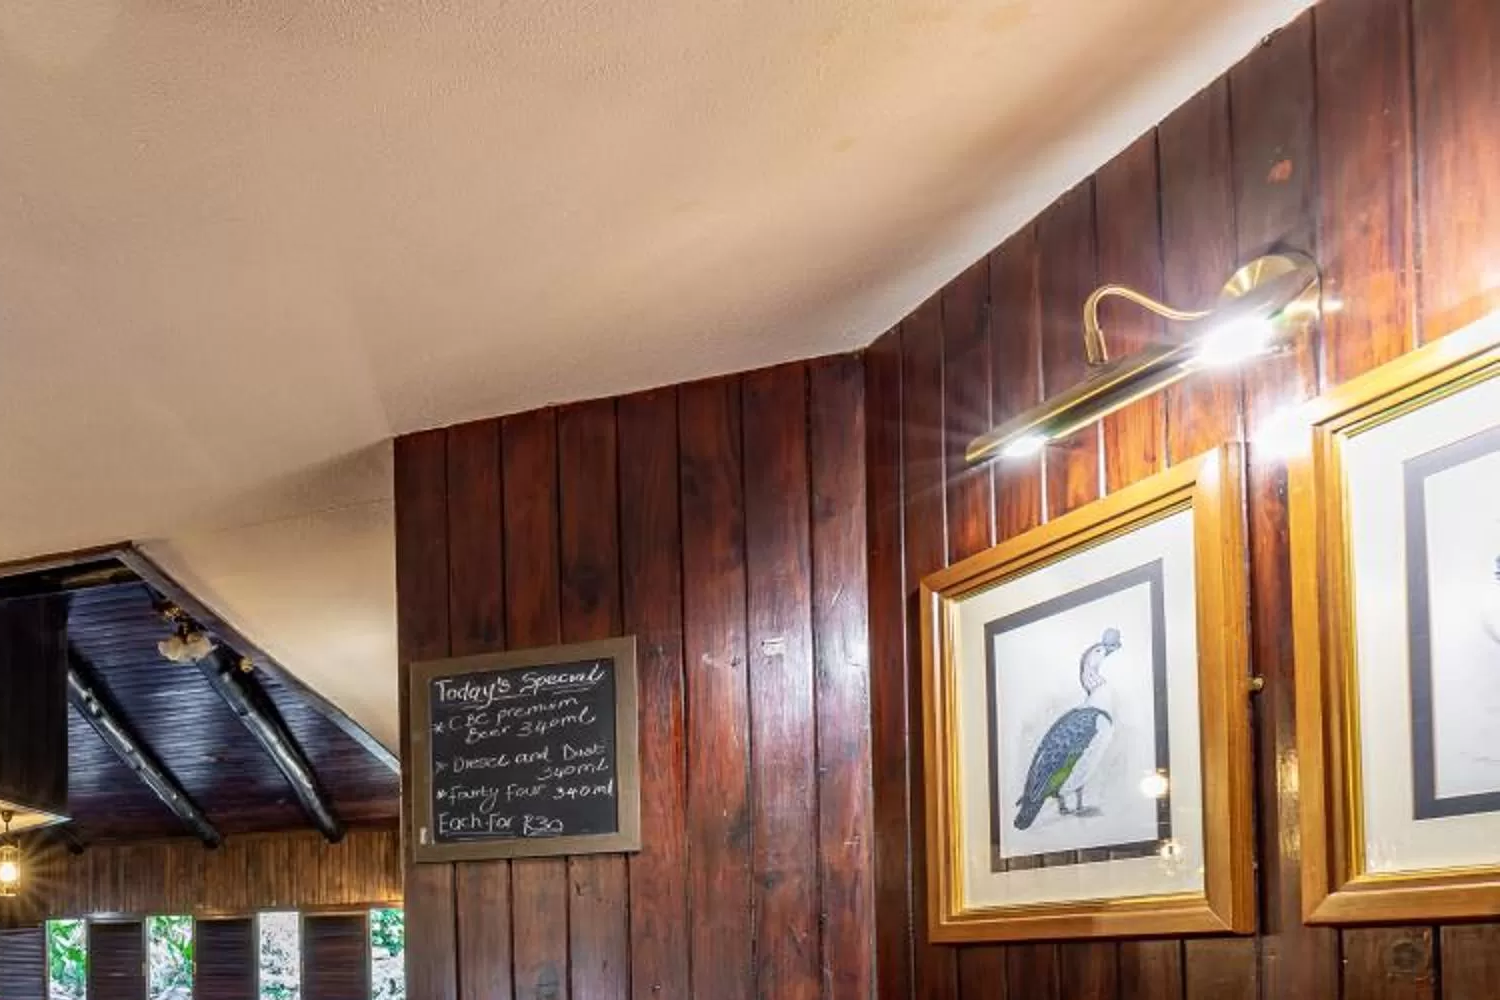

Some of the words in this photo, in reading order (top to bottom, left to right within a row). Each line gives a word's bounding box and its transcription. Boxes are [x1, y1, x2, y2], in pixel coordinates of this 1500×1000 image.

[435, 676, 511, 710] Today's
[520, 663, 605, 696] Special
[449, 713, 489, 731] CBC
[465, 727, 511, 745] Beer
[453, 754, 510, 773] Diesel
[514, 745, 550, 764] and
[438, 811, 482, 835] Each
[522, 813, 564, 836] R30
